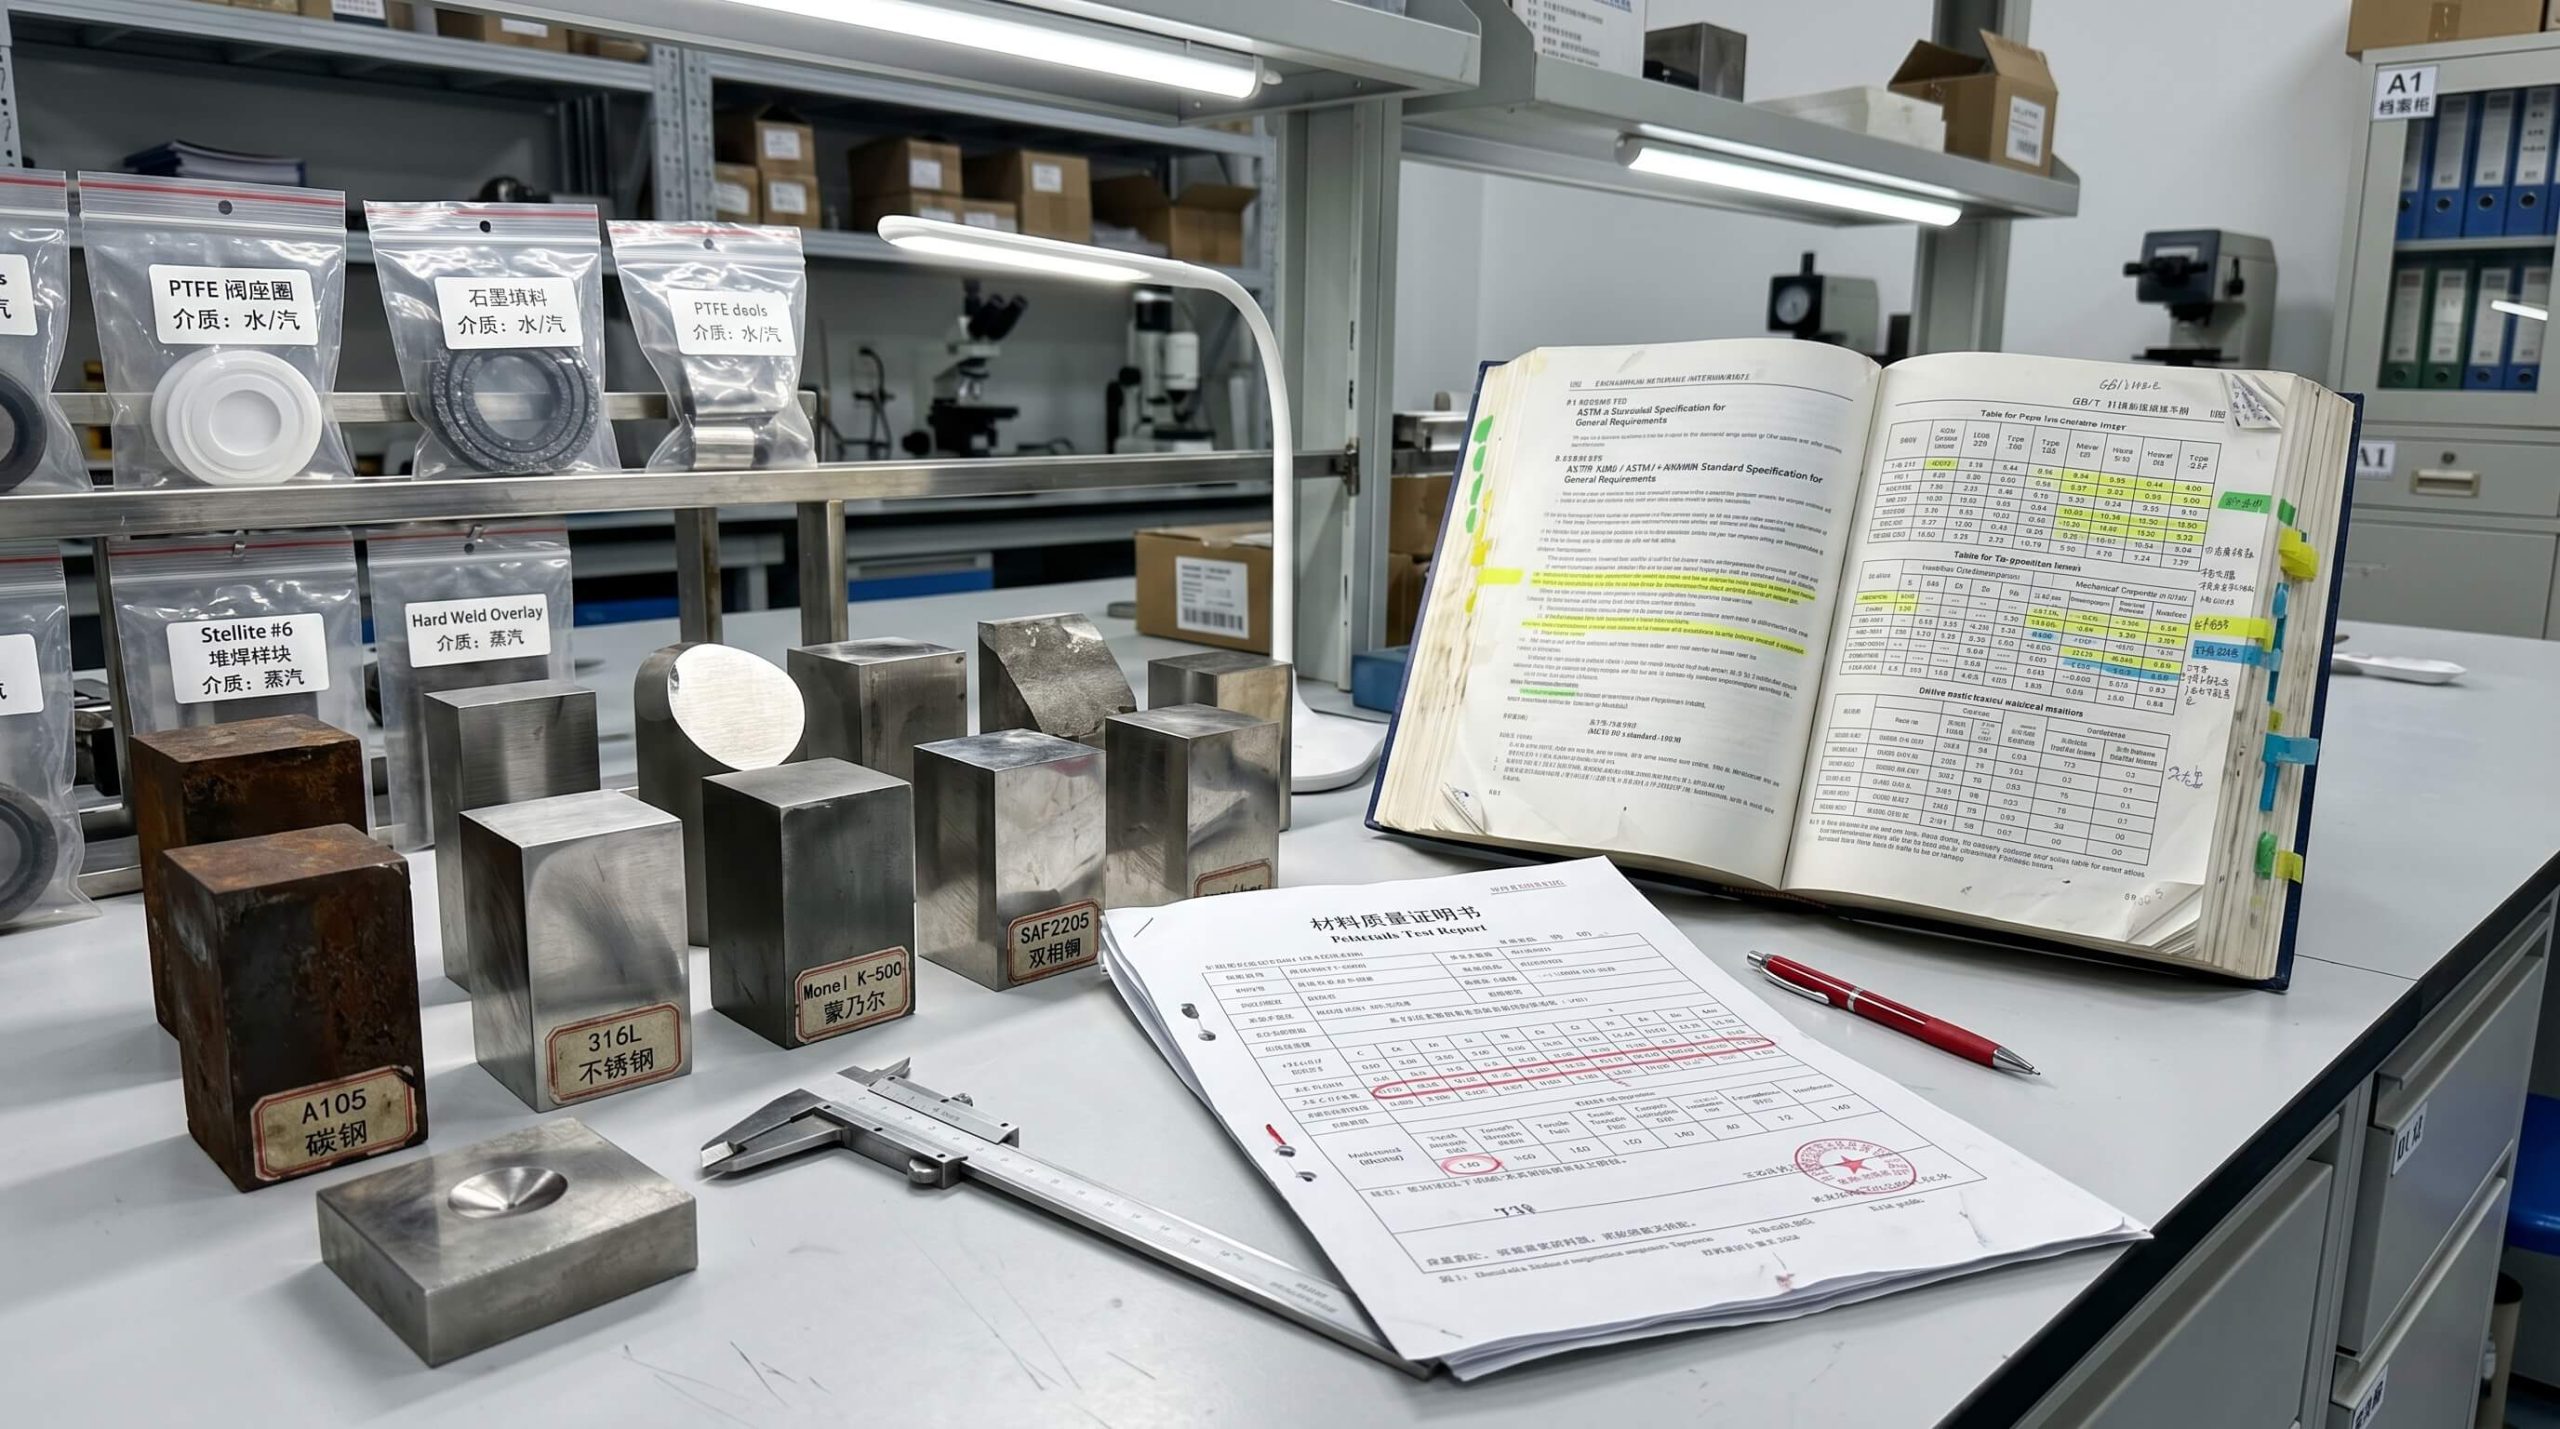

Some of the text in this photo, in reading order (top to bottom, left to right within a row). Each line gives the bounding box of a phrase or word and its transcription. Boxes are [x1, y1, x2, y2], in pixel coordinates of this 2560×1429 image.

[2387, 72, 2422, 94] A1
[169, 280, 294, 301] PTFE 阀座圈
[469, 288, 548, 308] 石墨填料
[694, 302, 729, 317] PTFE
[1577, 407, 1602, 417] ASTM
[1654, 404, 1711, 416] Specification
[1712, 403, 1726, 412] for
[2072, 397, 2101, 408] GB/T
[2004, 411, 2017, 420] for
[1564, 474, 1657, 486] General Requirements
[1701, 462, 1744, 472] Standard
[1746, 464, 1808, 481] Specification
[1810, 473, 1824, 485] for
[412, 605, 543, 628] Hard Weld Overlay
[201, 621, 293, 643] Stellite #6
[209, 645, 292, 667] 堆焊样块
[1020, 911, 1090, 944] SAF2205
[1310, 905, 1482, 932] 材料质量证明书
[1403, 928, 1435, 940] Test
[1437, 923, 1488, 937] Report
[803, 961, 902, 1001] Monel K-500
[824, 990, 885, 1025] 蒙乃尔
[588, 1024, 642, 1052] 316L
[579, 1047, 654, 1085] 不锈钢
[302, 1088, 367, 1125] A105
[305, 1120, 368, 1157] 碳钢
